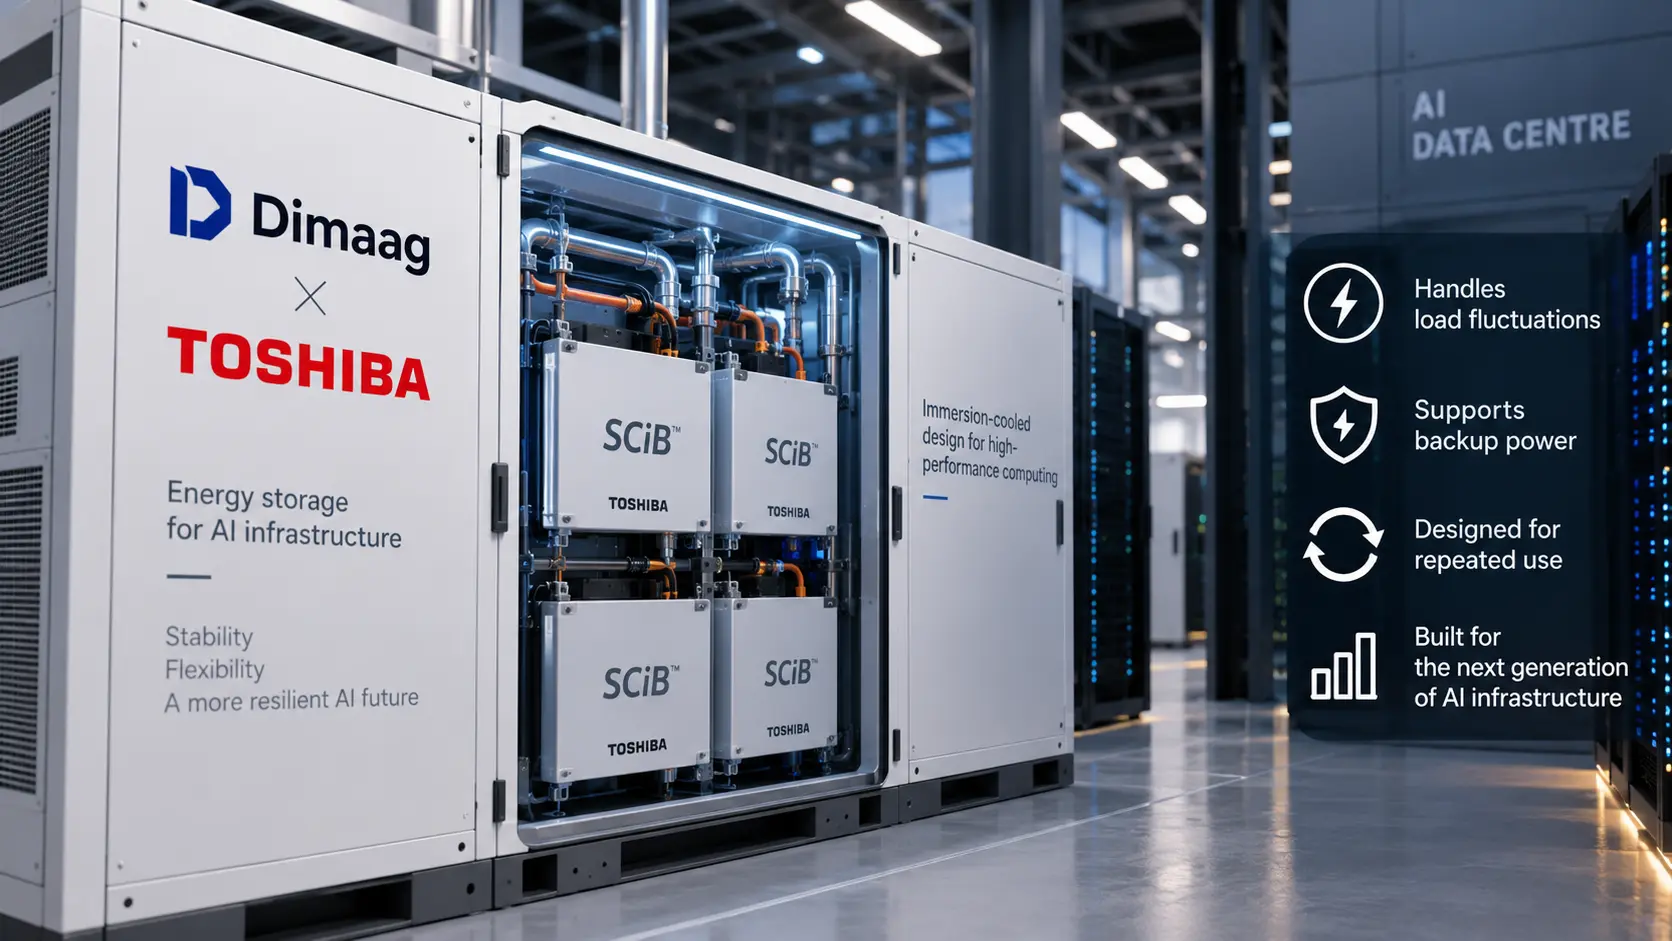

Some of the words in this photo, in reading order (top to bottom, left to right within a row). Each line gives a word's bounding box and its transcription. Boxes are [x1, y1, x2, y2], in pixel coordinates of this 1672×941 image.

[1413, 90, 1444, 120] AI
[1414, 126, 1492, 160] DATA
[1503, 110, 1630, 150] CENTRE
[254, 193, 429, 276] Dimaag
[168, 326, 430, 401] TOSHIBA
[923, 399, 1030, 432] Immersion-cooled
[923, 428, 964, 452] design
[968, 432, 985, 450] for
[989, 435, 1017, 458] high-
[923, 456, 1000, 478] performance
[1003, 467, 1058, 488] computing
[169, 480, 254, 512] Energy
[262, 489, 348, 517] storage
[609, 497, 668, 512] TOSHIBA
[768, 506, 810, 518] TOSHIBA
[167, 516, 203, 540] for
[211, 519, 235, 541] AI
[246, 520, 401, 548] infrastructure
[166, 626, 253, 651] Stability
[166, 659, 264, 684] Flexibility
[164, 693, 180, 713] A
[189, 697, 242, 712] more
[251, 690, 328, 710] resilient
[336, 689, 354, 707] AI
[362, 688, 418, 707] future
[767, 723, 809, 737] TOSHIBA
[608, 738, 667, 756] TOSHIBA
